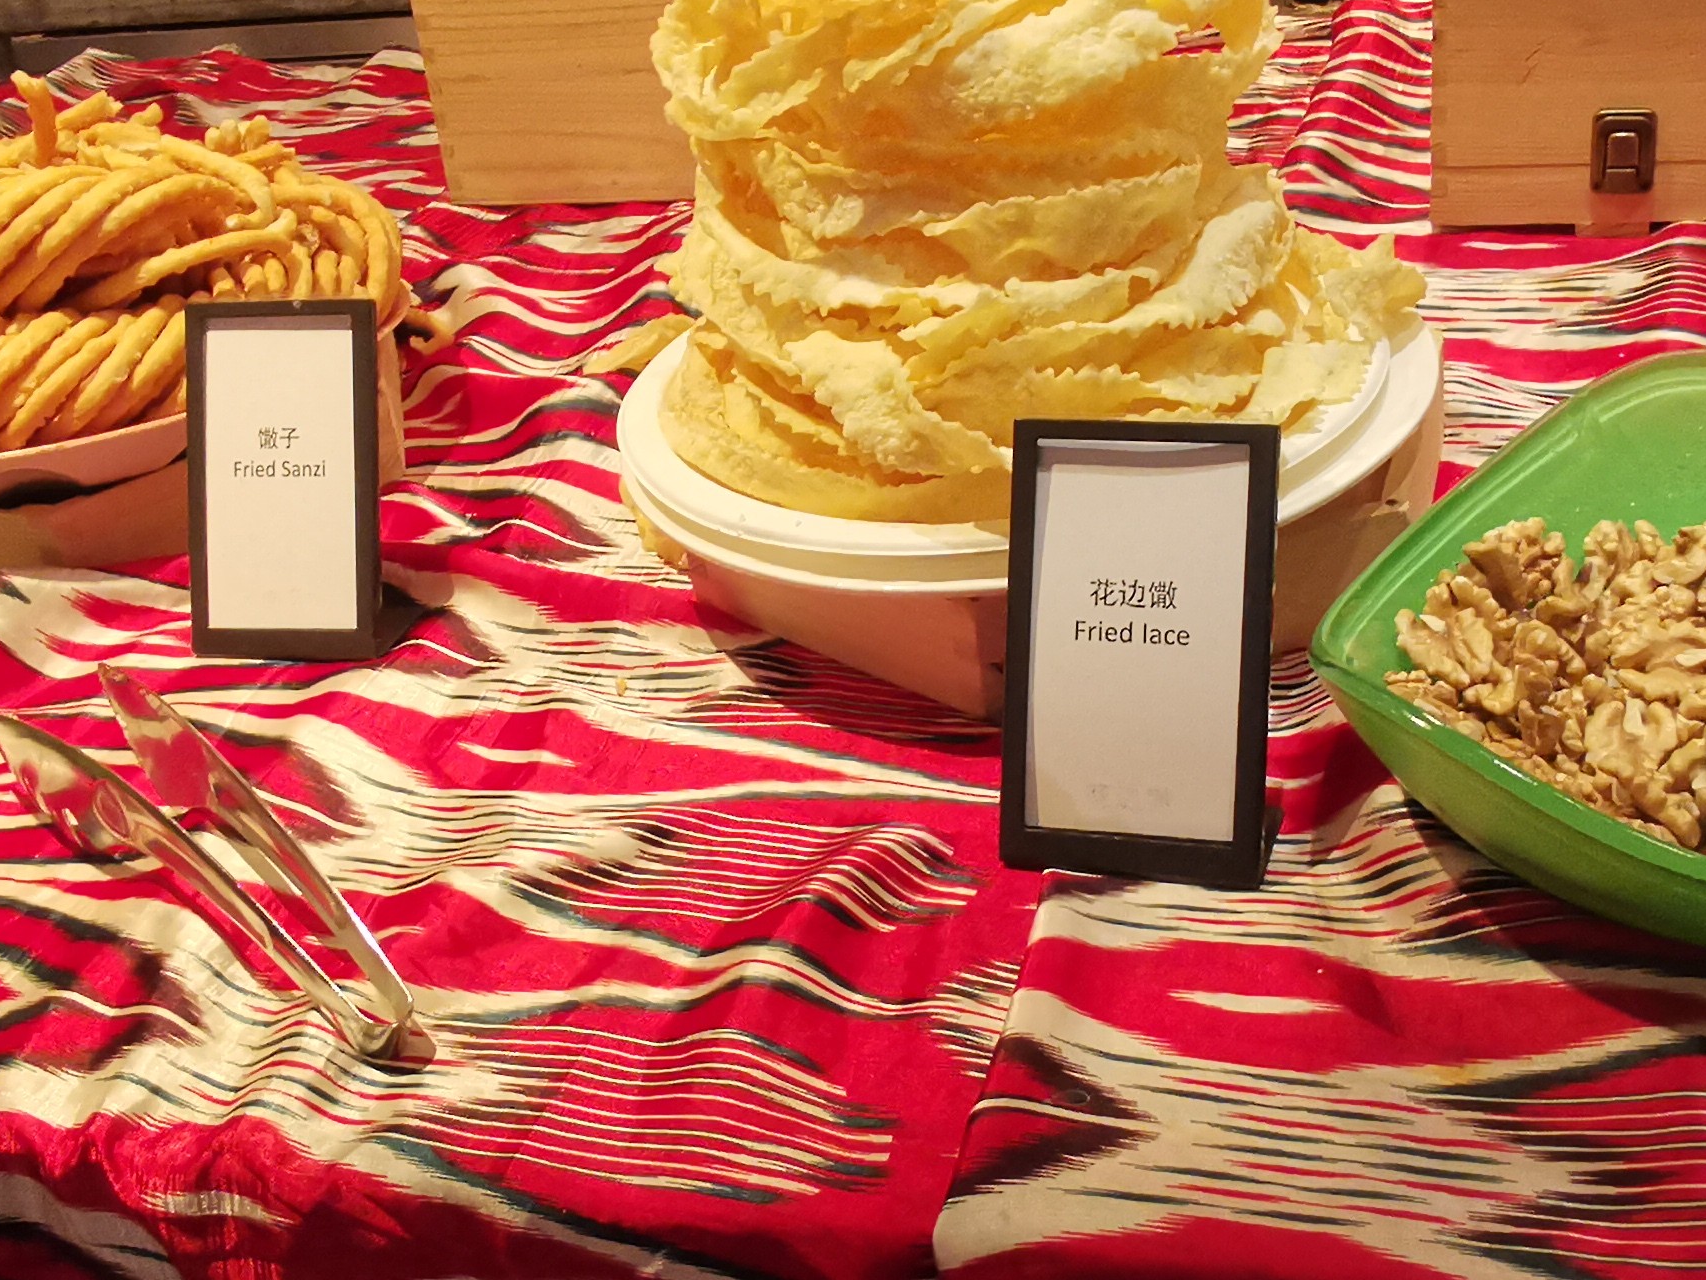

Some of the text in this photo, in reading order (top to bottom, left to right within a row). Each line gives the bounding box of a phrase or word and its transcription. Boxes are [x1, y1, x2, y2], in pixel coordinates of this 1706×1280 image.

[234, 460, 326, 478] Fried Sanzi
[1090, 578, 1178, 610] 花边馓
[1074, 620, 1191, 646] Fried lace
